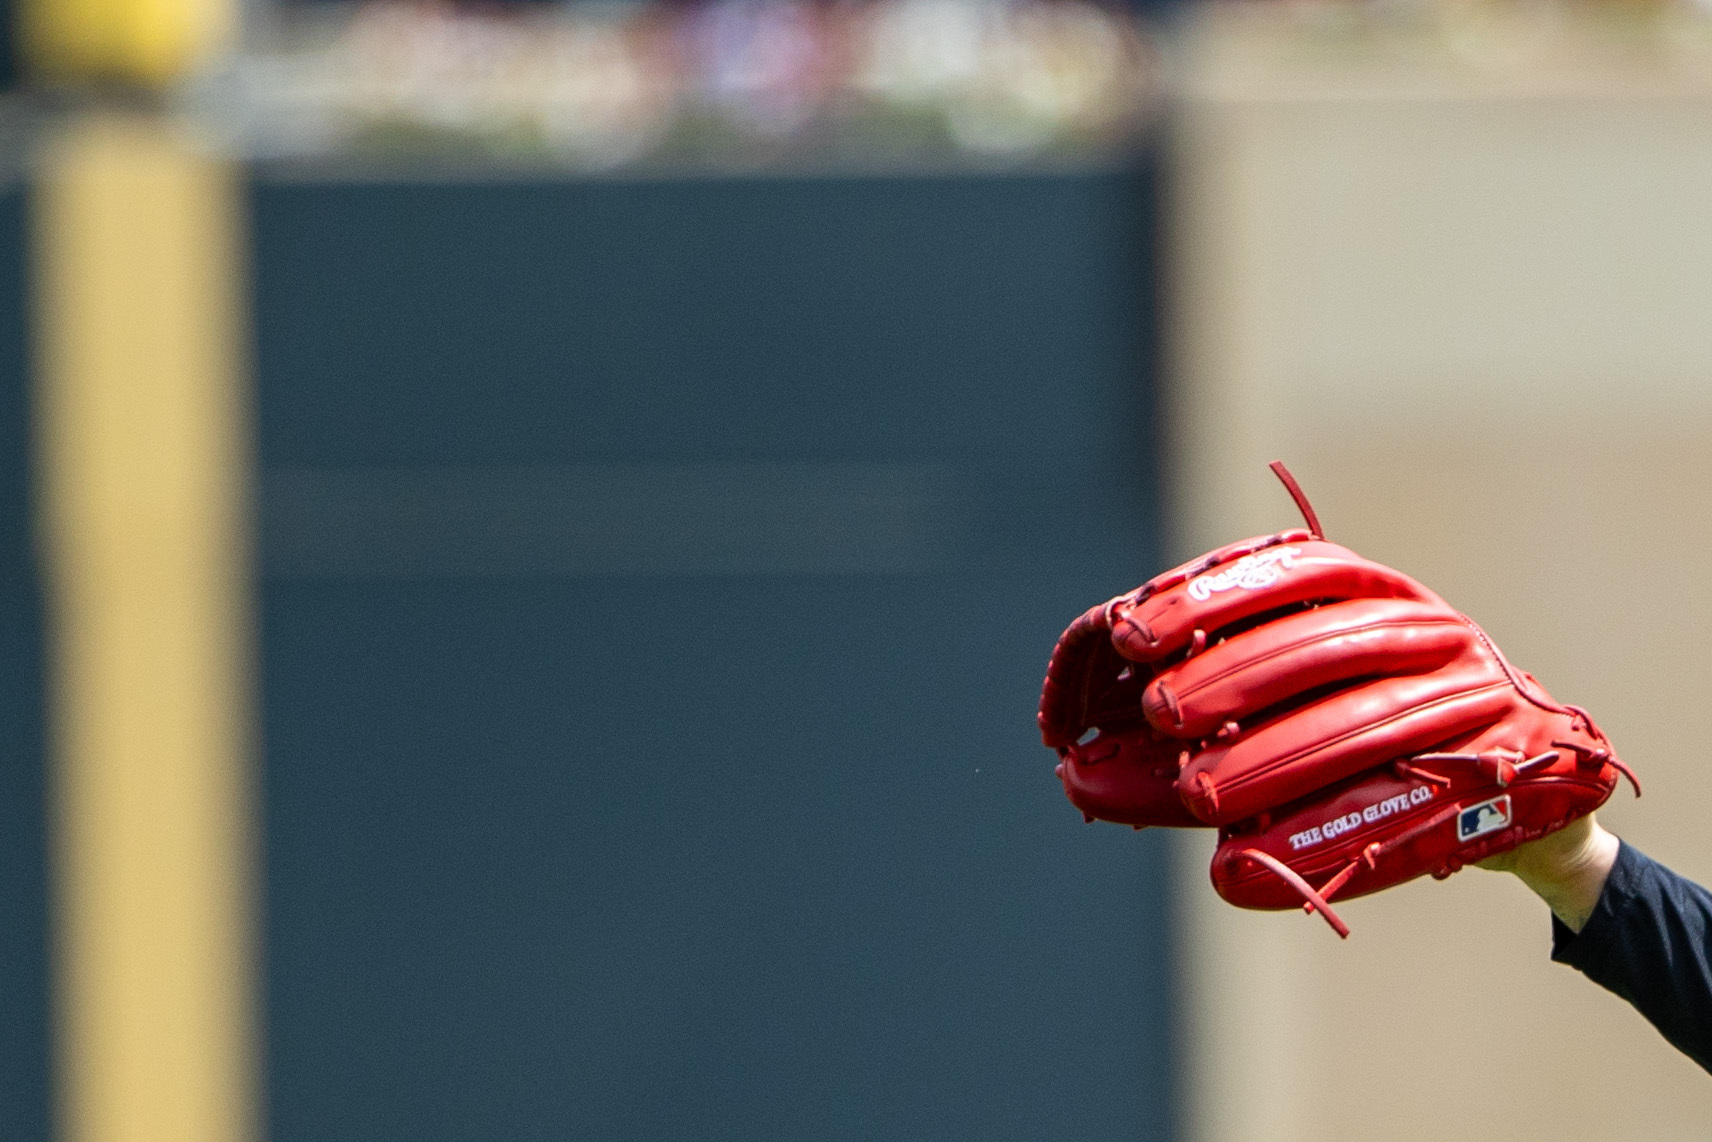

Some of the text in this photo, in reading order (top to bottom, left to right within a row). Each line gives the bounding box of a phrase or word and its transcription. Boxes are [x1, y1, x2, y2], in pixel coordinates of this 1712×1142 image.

[1289, 785, 1433, 850] THE GOLD GLOVE CO.
